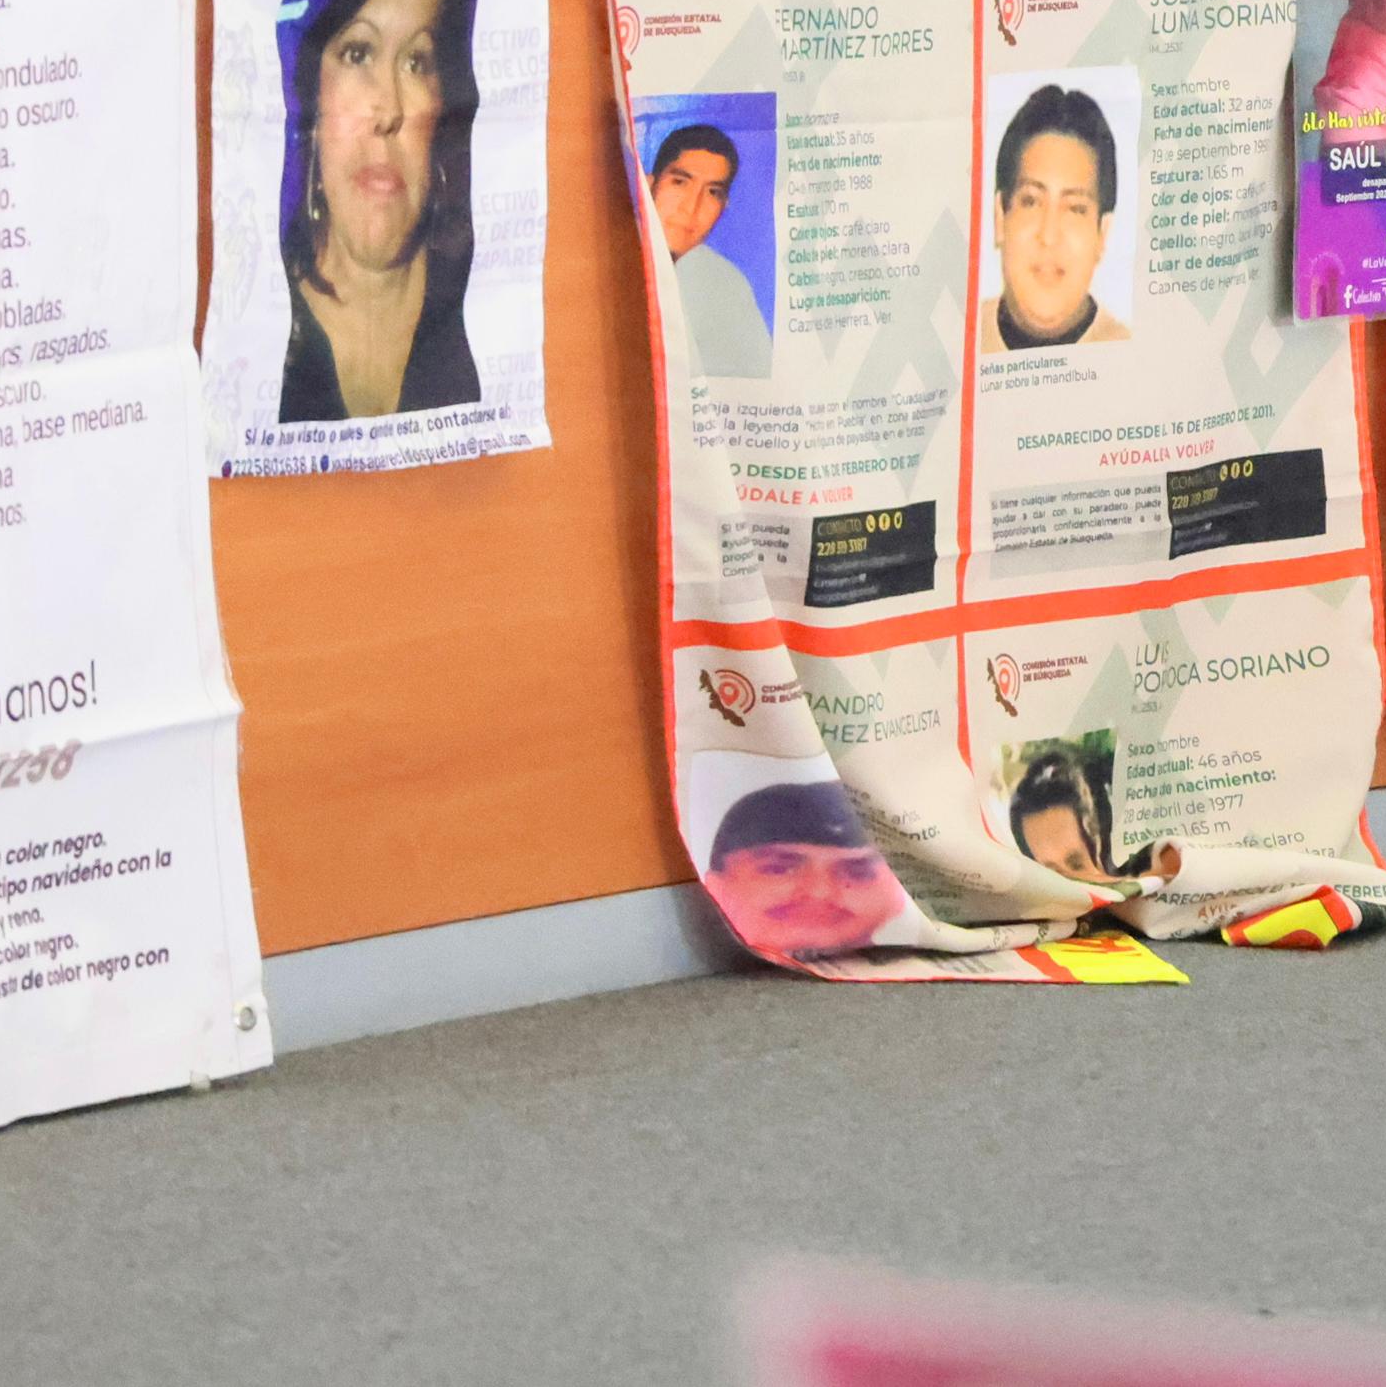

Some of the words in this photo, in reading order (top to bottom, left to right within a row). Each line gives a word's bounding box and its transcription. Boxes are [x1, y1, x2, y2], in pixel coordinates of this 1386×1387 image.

[871, 28, 933, 57] TORRES
[1329, 140, 1382, 171] SAÚL
[1018, 429, 1112, 450] DESAPARECIDO
[747, 464, 806, 479] DESDE
[1207, 646, 1330, 682] SORIANO
[1222, 751, 1262, 766] años
[1176, 770, 1276, 793] nacimiento:
[1208, 794, 1243, 811] 1977
[6, 842, 49, 865] color
[52, 832, 105, 859] negro.
[32, 859, 113, 892] navideño
[135, 948, 169, 968] con
